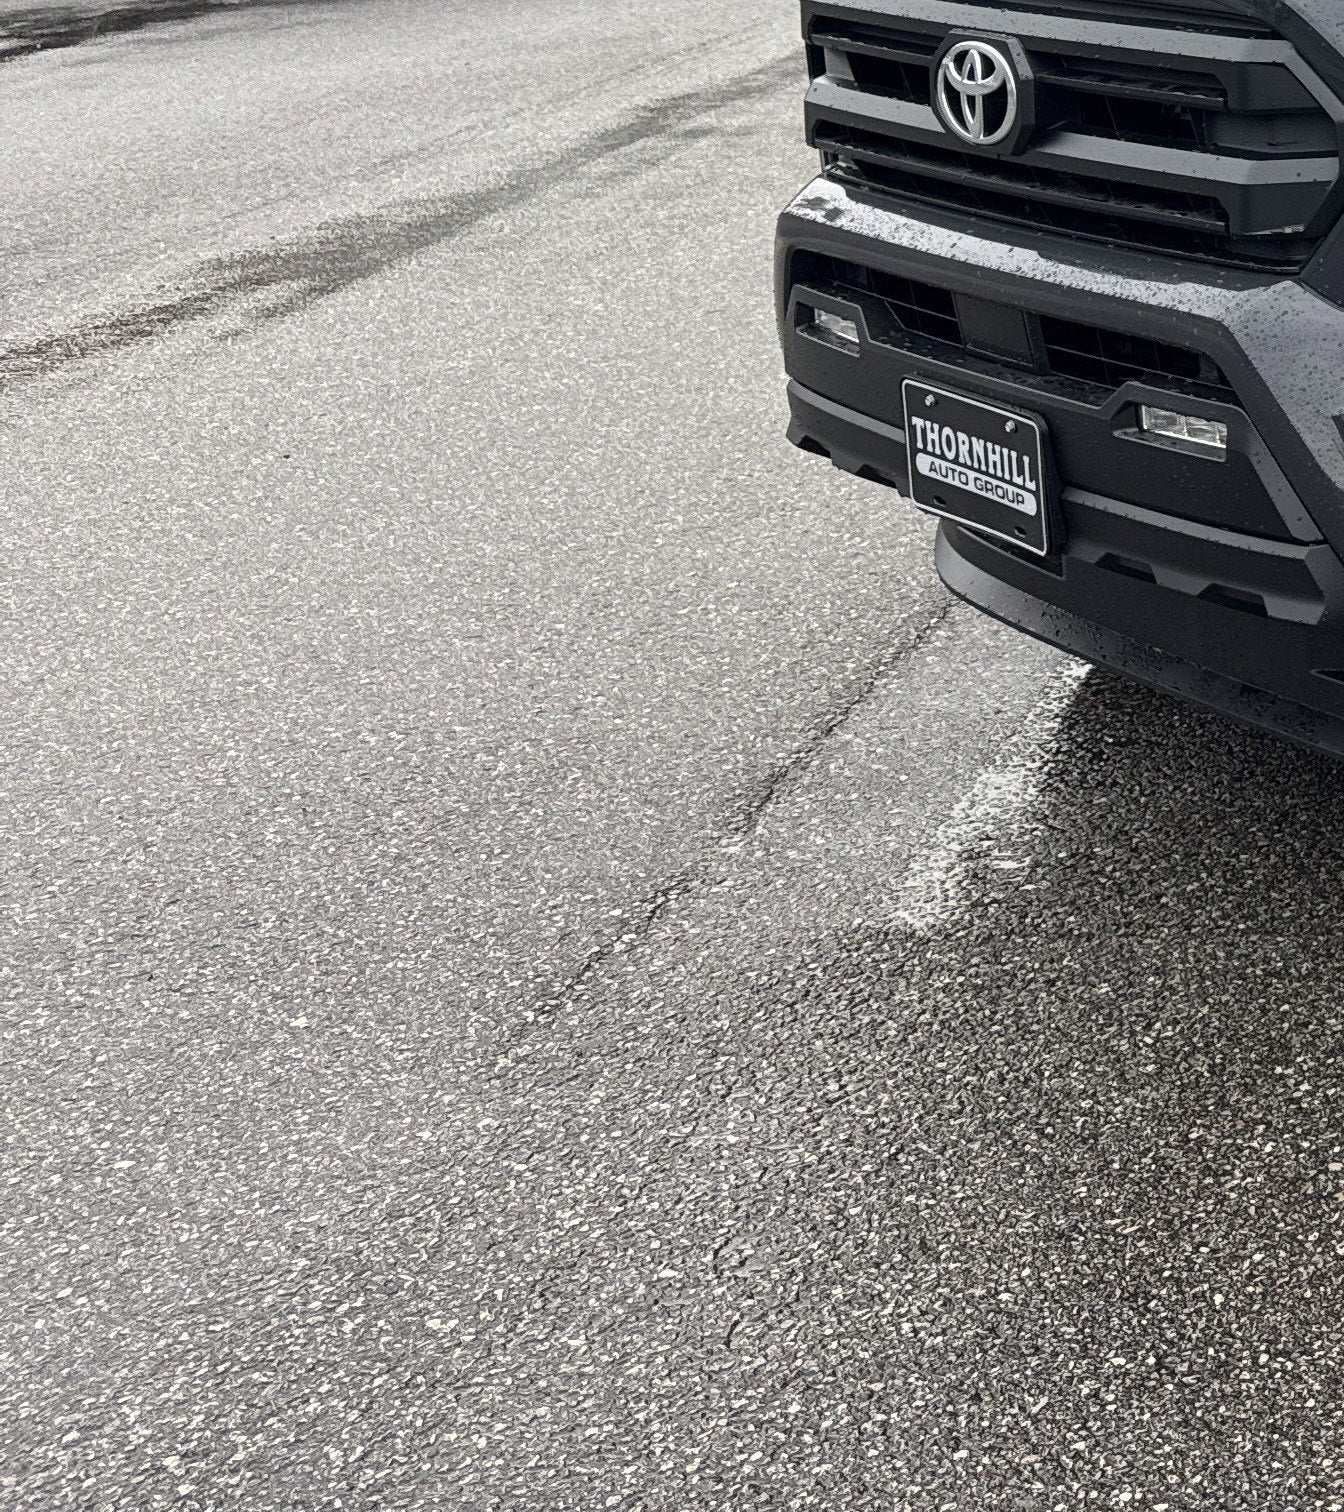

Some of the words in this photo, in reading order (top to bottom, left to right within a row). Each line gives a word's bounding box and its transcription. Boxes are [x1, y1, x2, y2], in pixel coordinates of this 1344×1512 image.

[911, 415, 1037, 492] THORNHILL
[928, 460, 969, 487] AUTO
[973, 476, 1025, 506] GROUP
